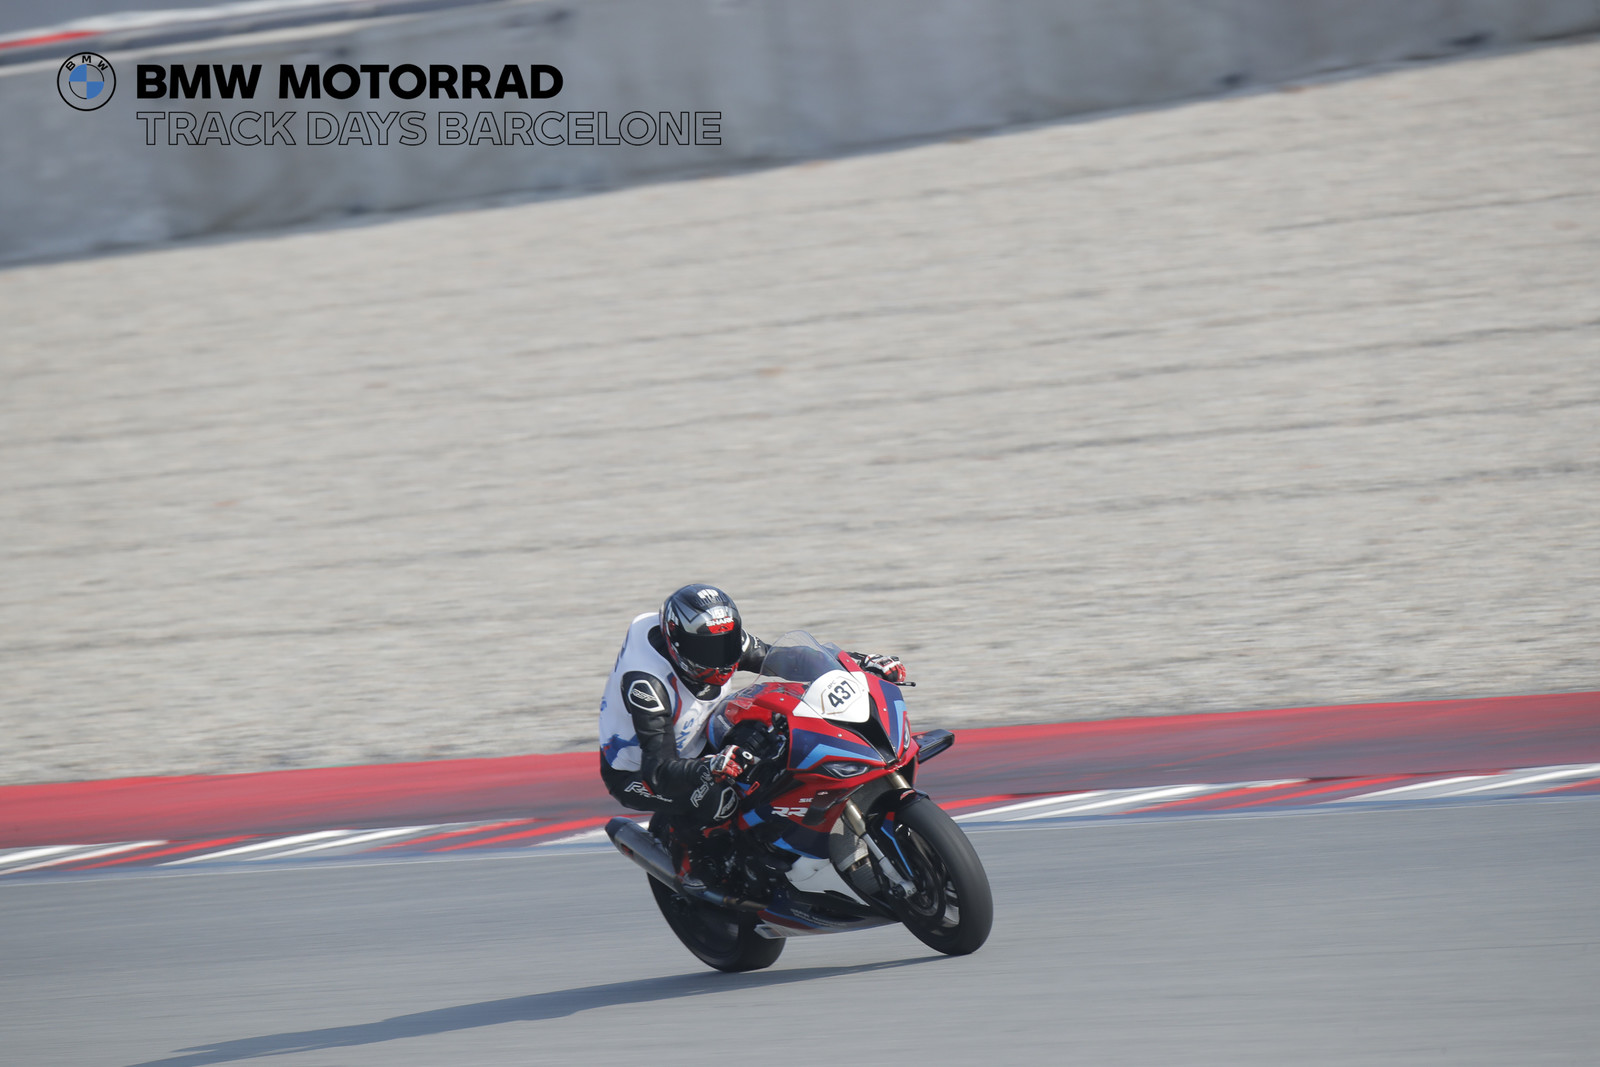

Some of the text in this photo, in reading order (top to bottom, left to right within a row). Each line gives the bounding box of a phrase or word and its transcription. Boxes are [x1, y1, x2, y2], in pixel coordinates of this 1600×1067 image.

[705, 616, 735, 627] SHARK
[828, 680, 856, 708] 437
[771, 806, 809, 818] RR
